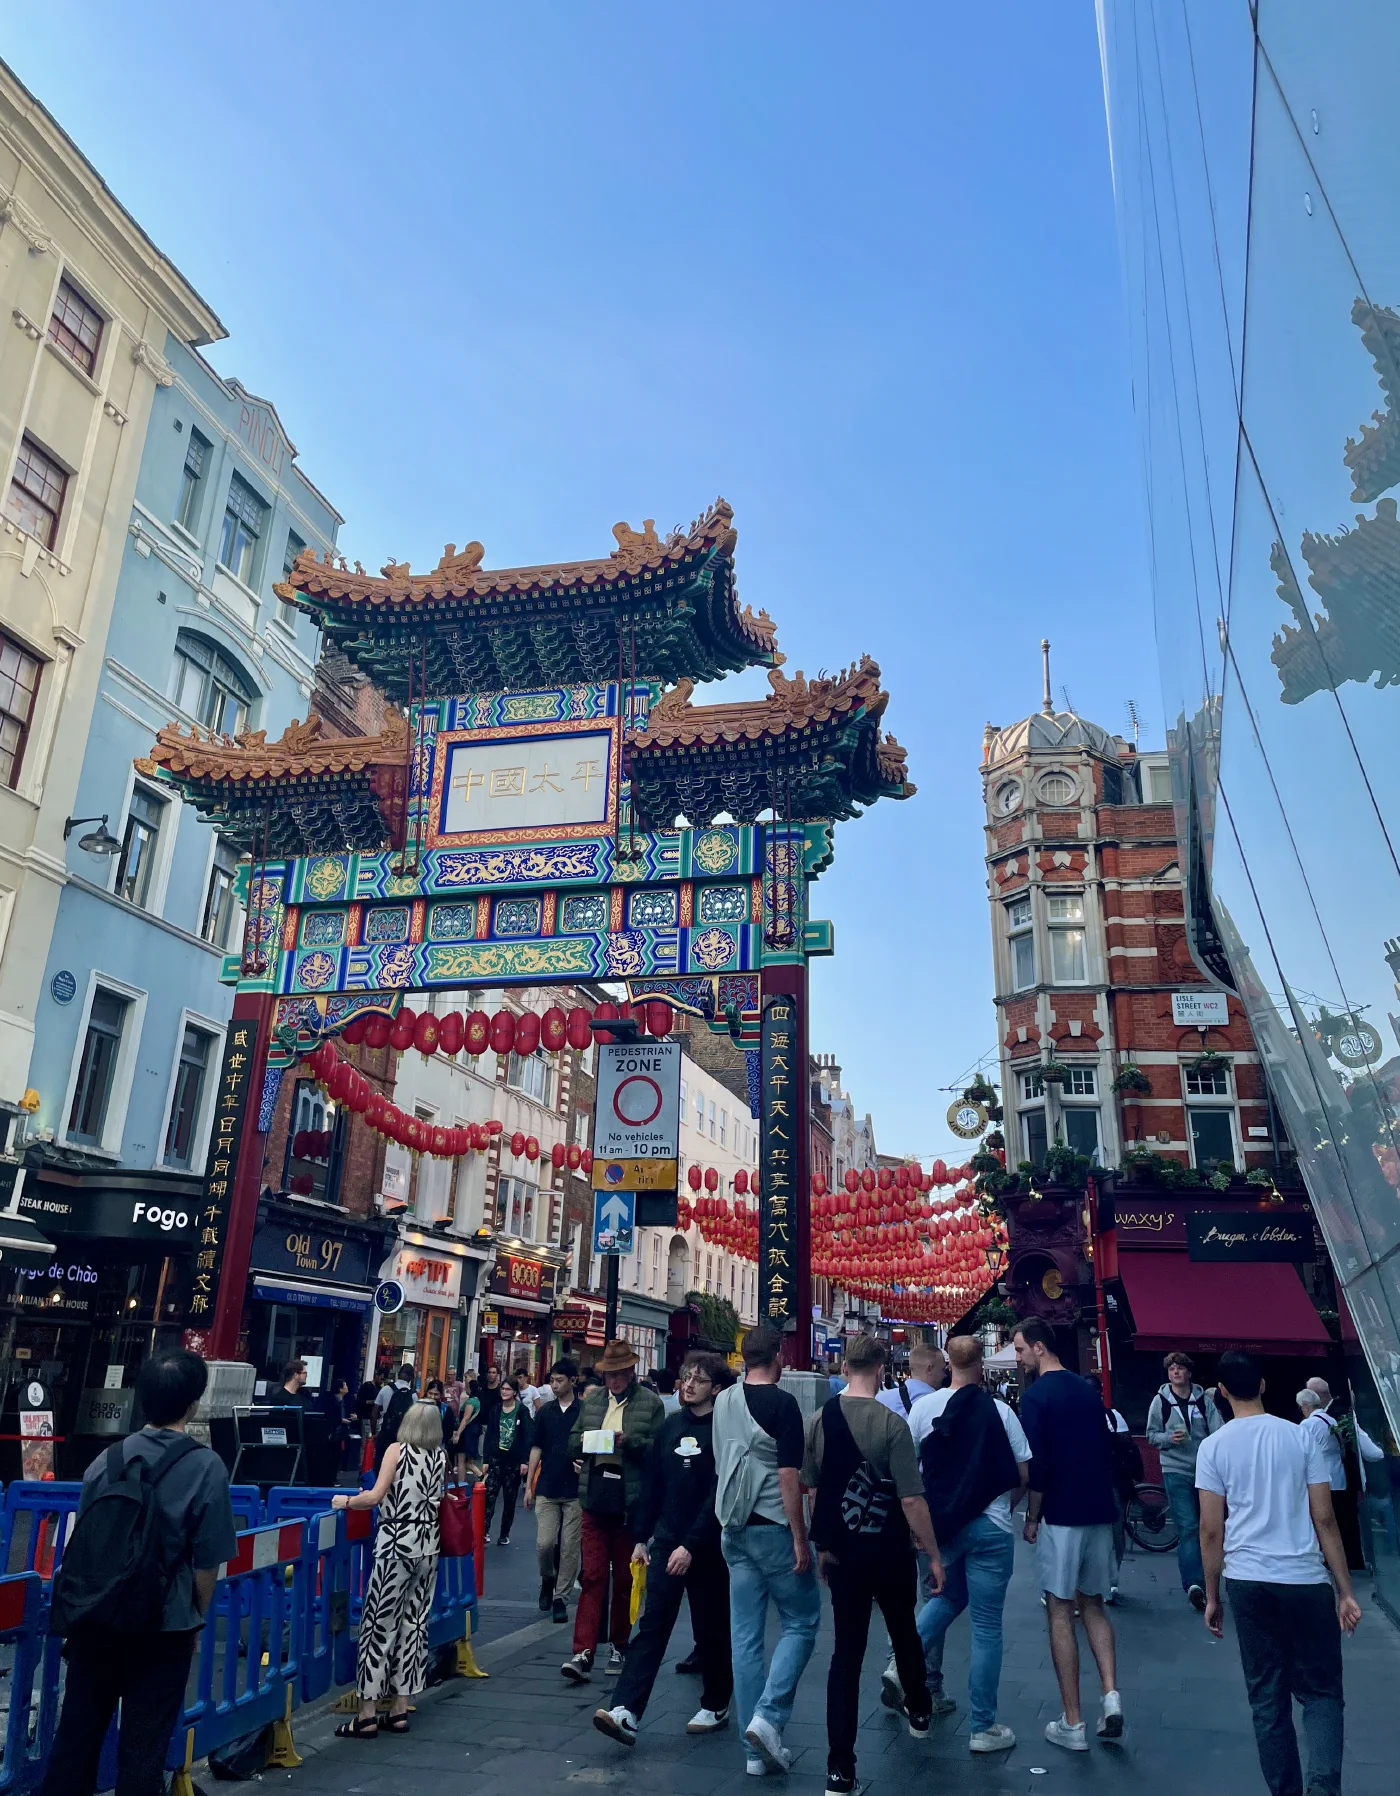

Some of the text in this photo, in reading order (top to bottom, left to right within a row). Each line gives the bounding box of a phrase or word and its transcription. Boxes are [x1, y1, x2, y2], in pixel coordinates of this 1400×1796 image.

[237, 404, 285, 477] PINOLI
[453, 760, 604, 802] 中國太平
[1177, 1002, 1219, 1010] STREET WC2
[608, 1046, 673, 1057] PEDESTRIAN
[615, 1058, 662, 1073] ZONE
[608, 1132, 664, 1141] No vehicles
[633, 1143, 648, 1155] 10
[651, 1144, 671, 1157] pm
[20, 1196, 69, 1214] STEAK HOUSE
[132, 1202, 189, 1231] Fogo
[286, 1233, 344, 1272] Old 97
[295, 1253, 318, 1270] Town
[48, 1262, 64, 1280] de
[427, 1260, 452, 1284] TPT
[66, 1300, 89, 1310] HOUSE
